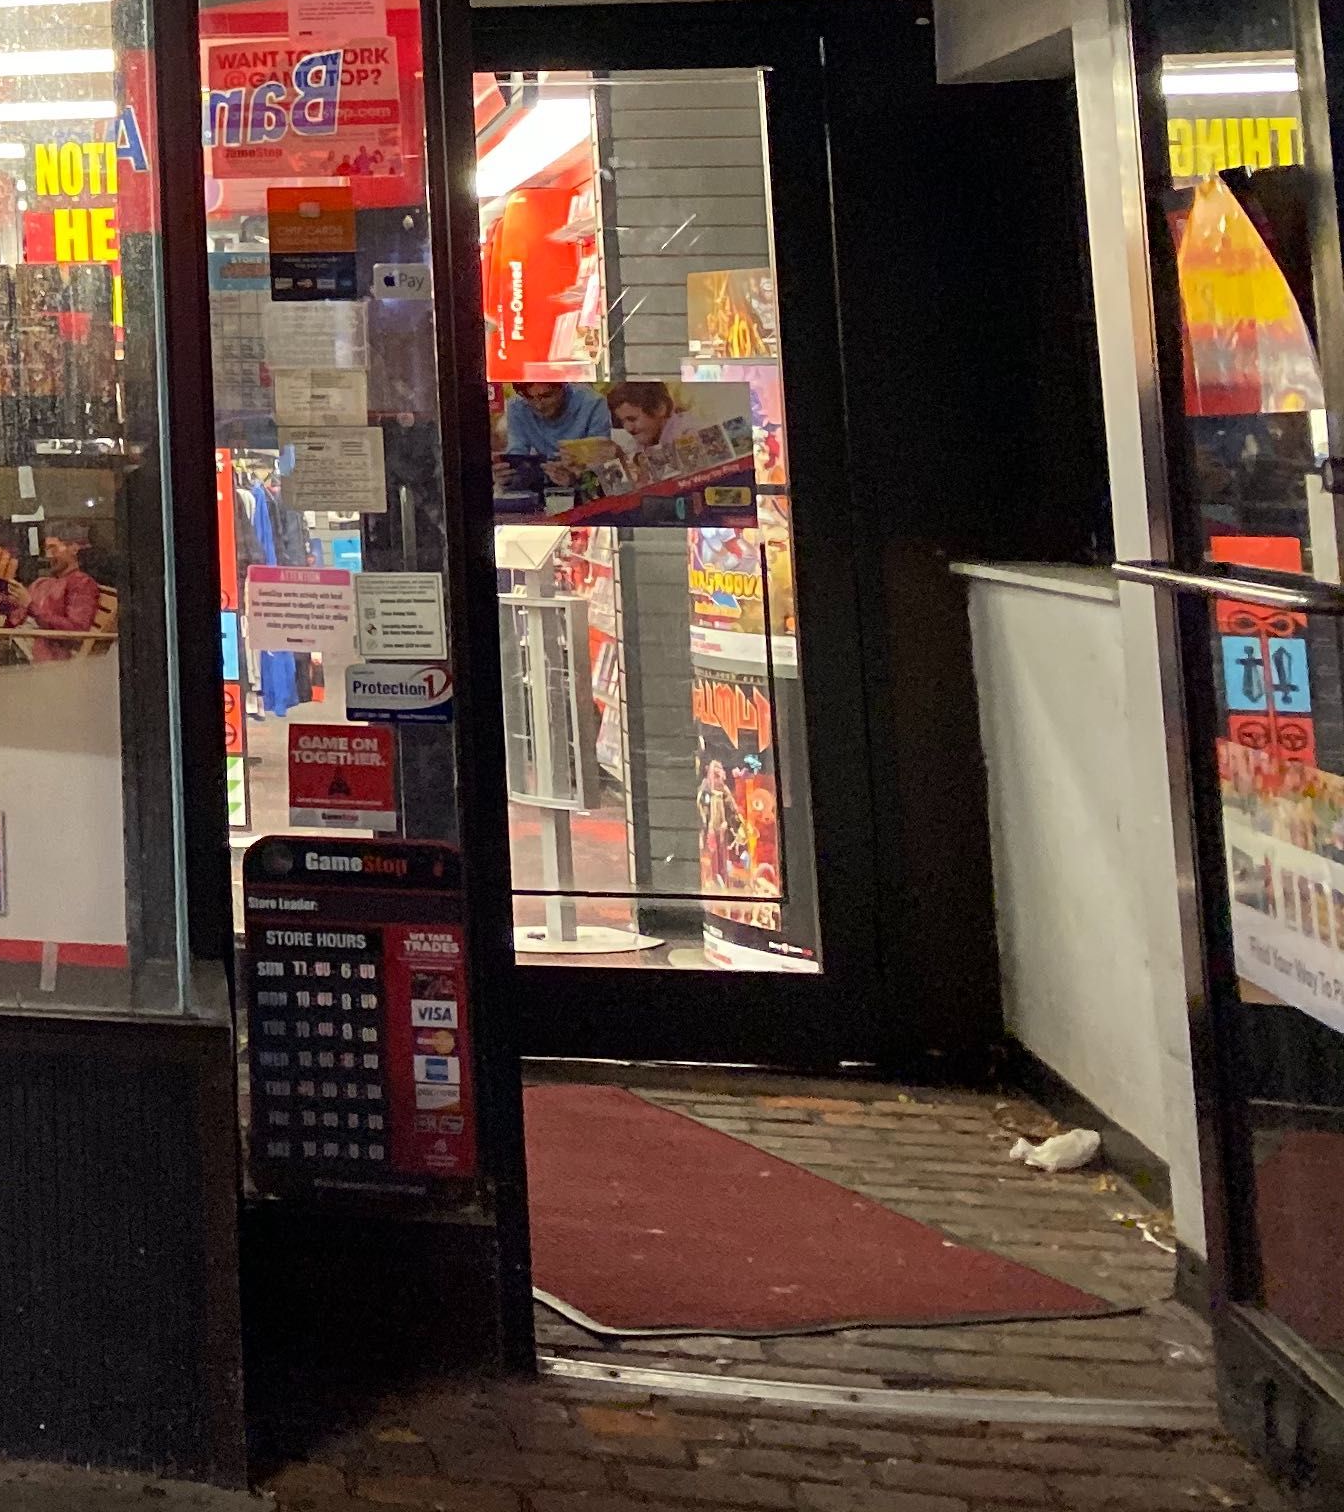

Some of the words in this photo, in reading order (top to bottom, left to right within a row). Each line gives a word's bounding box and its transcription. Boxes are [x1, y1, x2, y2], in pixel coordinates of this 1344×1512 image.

[217, 50, 279, 69] WANT
[319, 46, 390, 67] WORK
[399, 272, 426, 291] Pay
[509, 261, 525, 340] Pre-Owned
[298, 735, 349, 751] GAME
[352, 737, 379, 752] ON
[305, 851, 408, 877] GameStop
[247, 895, 278, 910] Store
[266, 930, 313, 947] STORE
[316, 932, 367, 950] HOURS
[403, 940, 460, 954] TRADES
[417, 1007, 453, 1022] VISA
